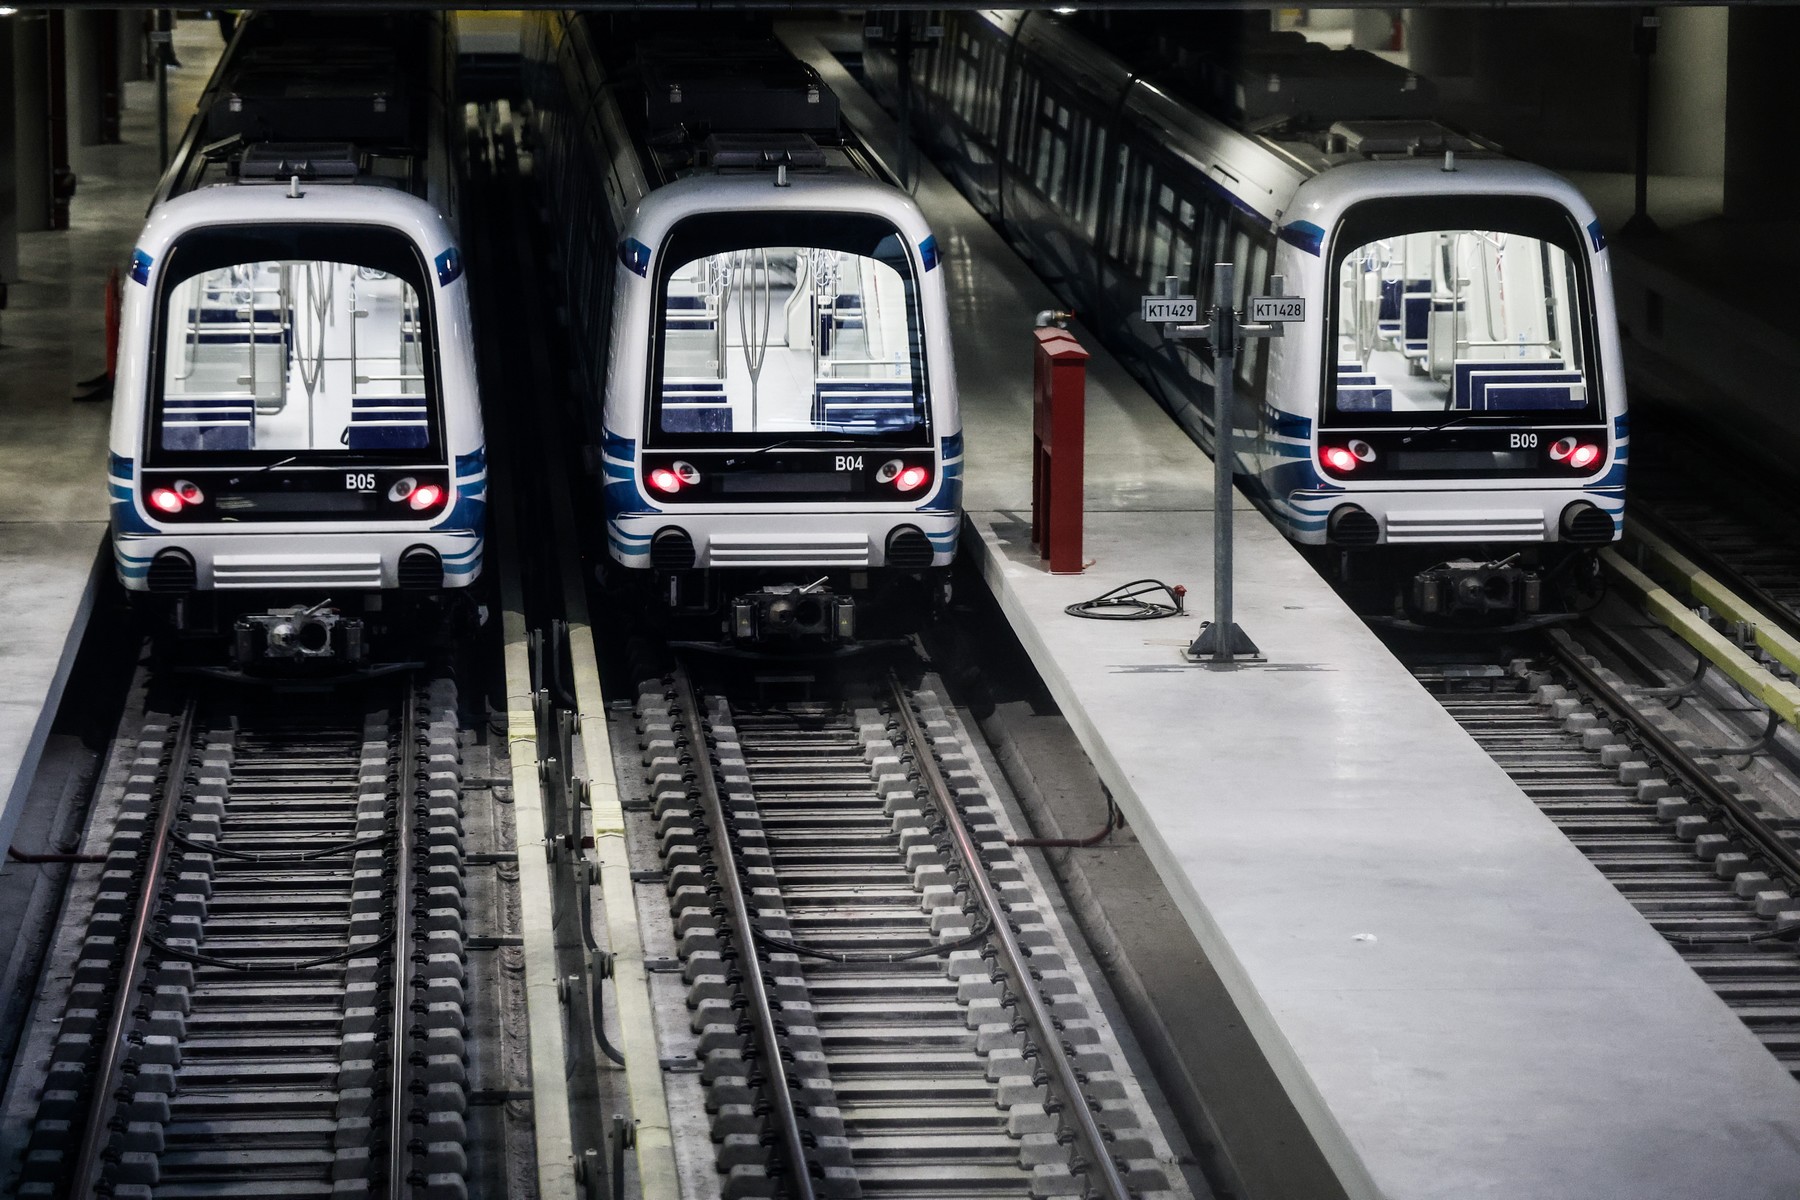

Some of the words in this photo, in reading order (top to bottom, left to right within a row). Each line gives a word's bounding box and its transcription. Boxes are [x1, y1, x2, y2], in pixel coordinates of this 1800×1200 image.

[1149, 305, 1194, 317] KT1429
[1256, 304, 1302, 316] KT1428
[1510, 434, 1538, 448] B09
[835, 455, 864, 471] B04
[345, 473, 376, 490] B05
